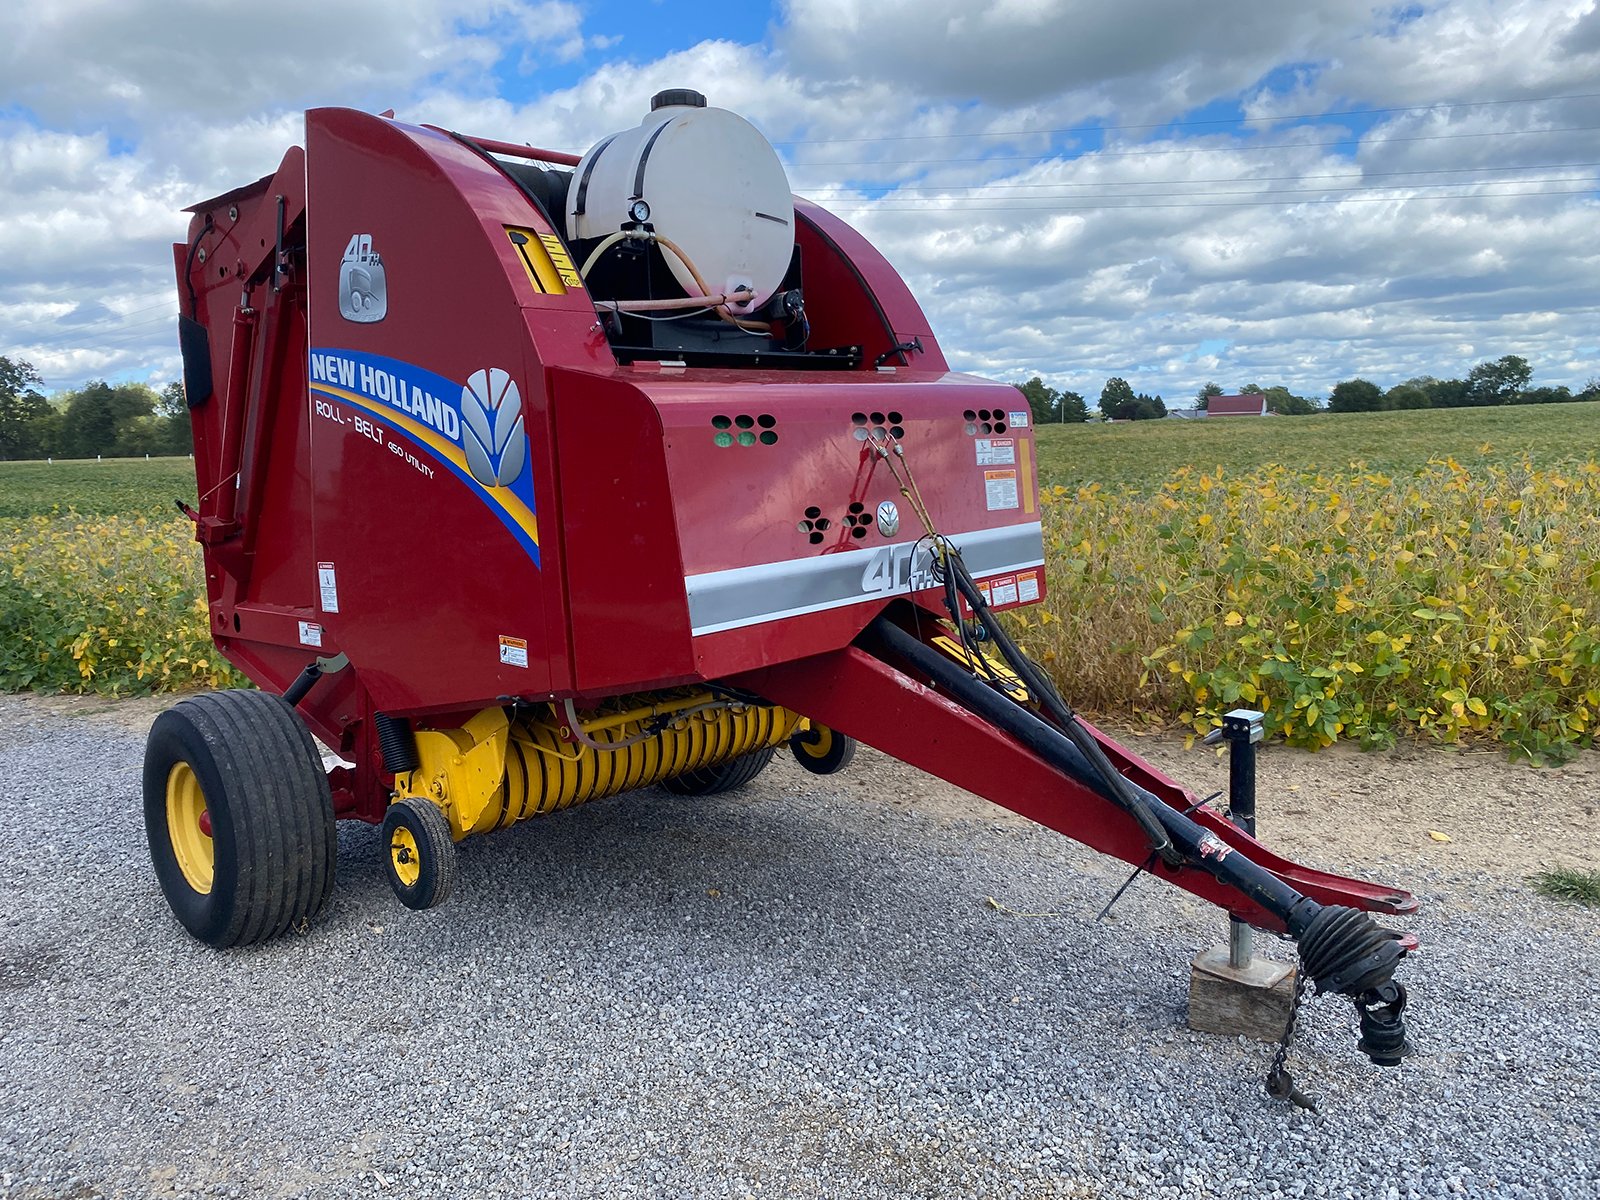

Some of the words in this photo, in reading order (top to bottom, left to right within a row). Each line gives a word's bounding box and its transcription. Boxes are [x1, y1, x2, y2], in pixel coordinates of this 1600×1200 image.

[311, 353, 356, 389] NEW
[359, 363, 460, 441] HOLLAND
[315, 400, 345, 425] ROLL
[354, 416, 384, 445] BELT
[387, 441, 404, 457] 450
[405, 451, 435, 480] UTILITY
